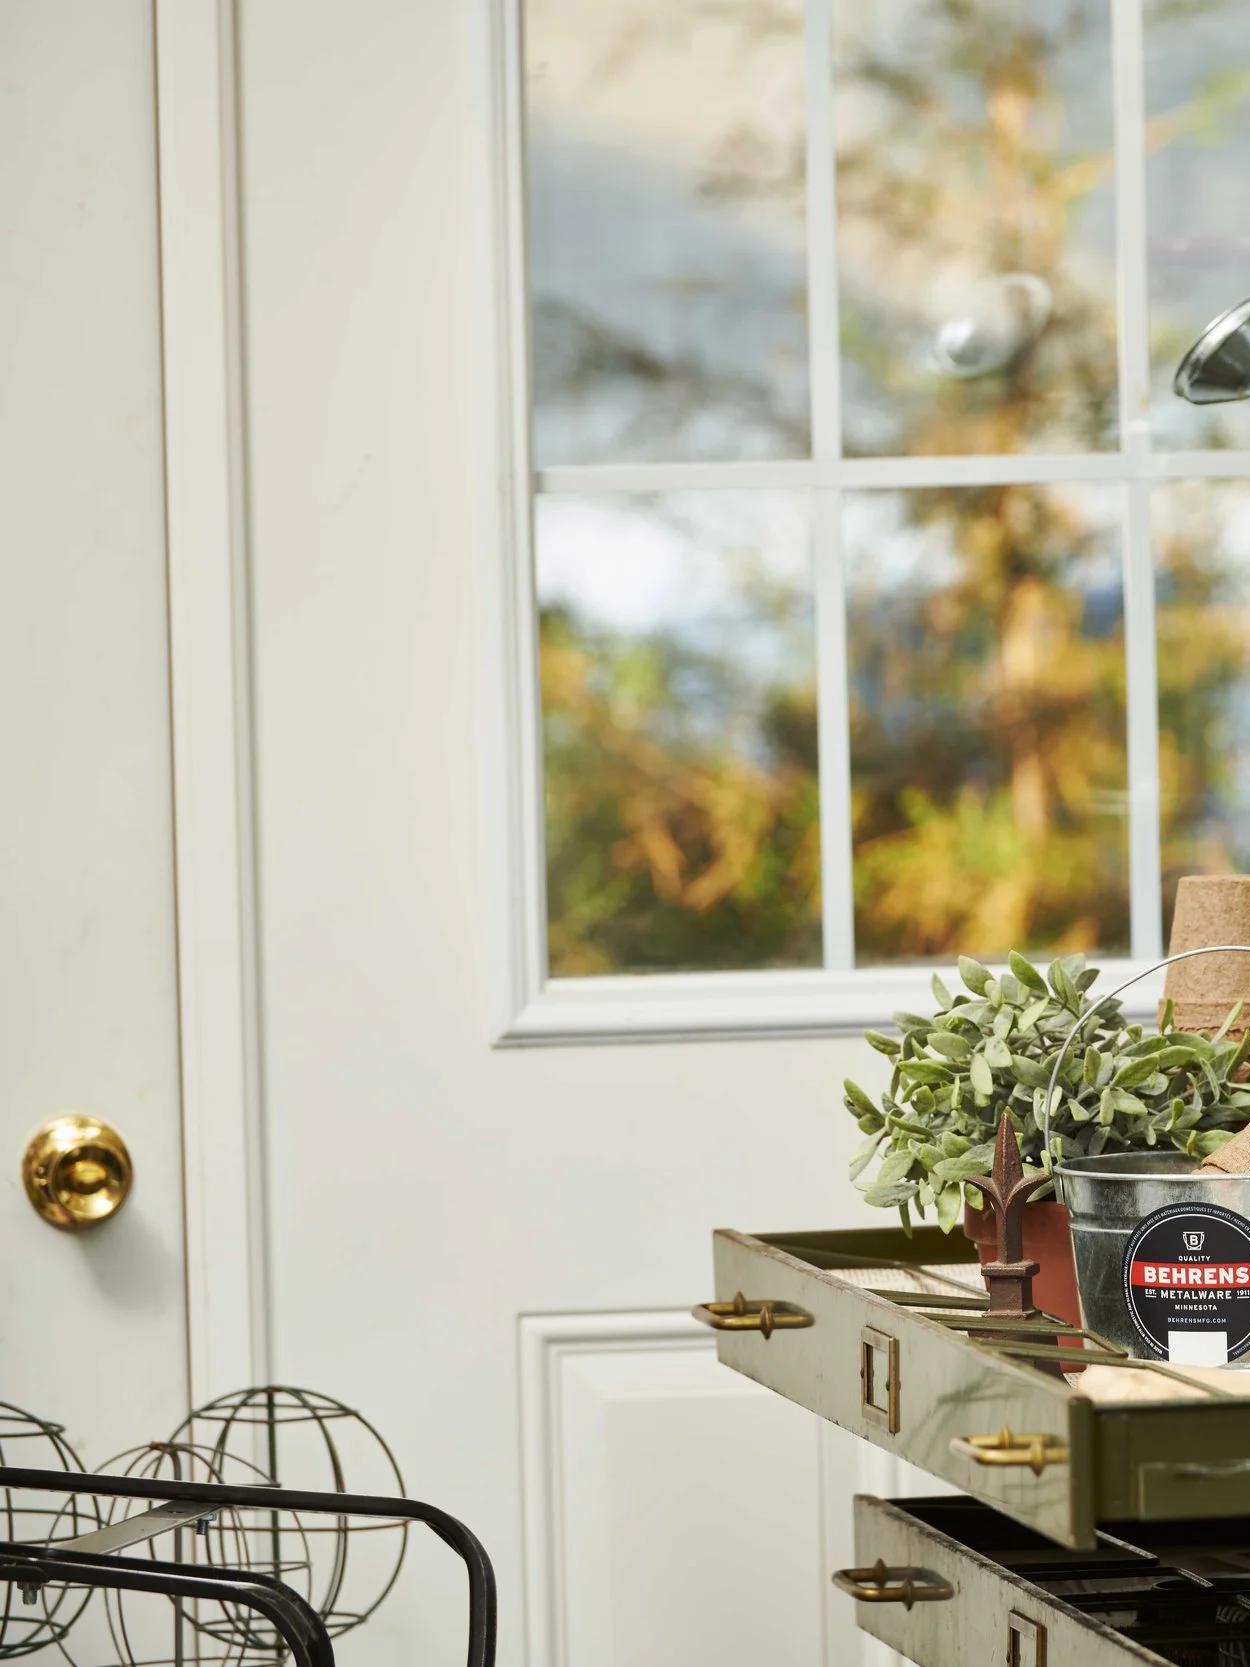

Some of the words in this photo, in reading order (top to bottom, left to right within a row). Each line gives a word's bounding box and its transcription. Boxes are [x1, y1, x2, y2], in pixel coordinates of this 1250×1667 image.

[1189, 1235, 1198, 1245] B
[1144, 1266, 1250, 1284] BEHRENS
[1161, 1290, 1232, 1300] METALWARE
